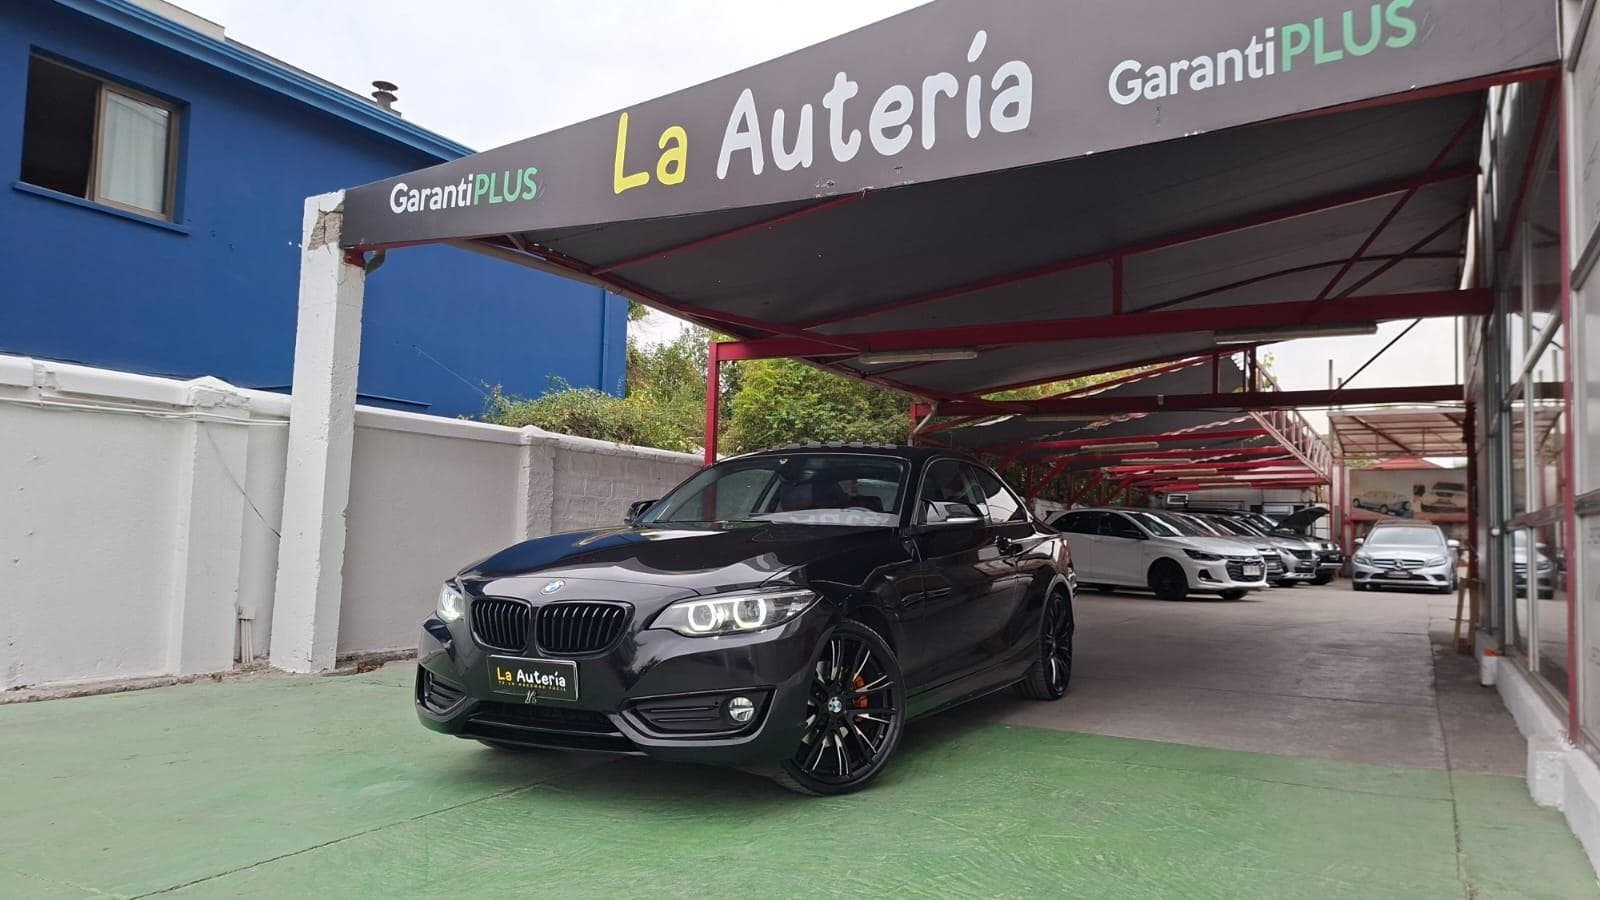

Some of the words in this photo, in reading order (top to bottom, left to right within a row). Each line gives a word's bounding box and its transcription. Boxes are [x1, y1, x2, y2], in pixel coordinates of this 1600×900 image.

[1108, 0, 1418, 106] GarantiPLUS
[613, 112, 689, 194] La
[716, 29, 1033, 180] Autería
[389, 166, 539, 214] GarantiPLUS
[497, 666, 512, 681] La
[517, 669, 566, 687] Autería
